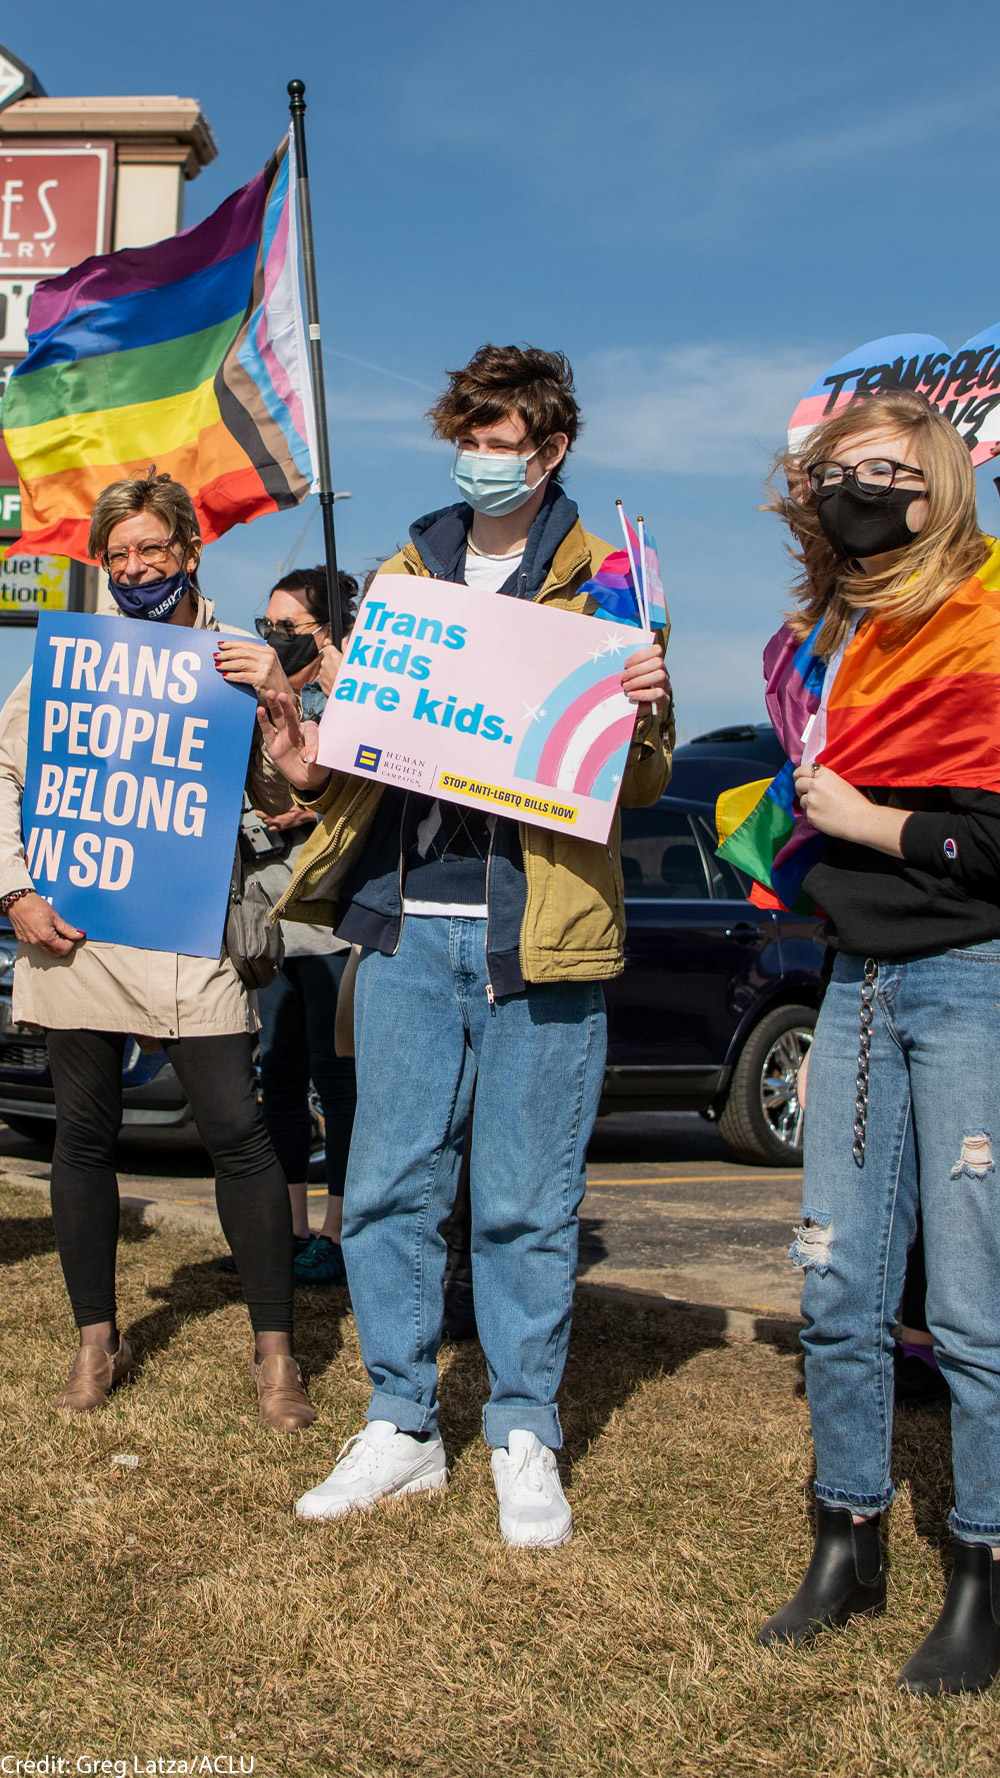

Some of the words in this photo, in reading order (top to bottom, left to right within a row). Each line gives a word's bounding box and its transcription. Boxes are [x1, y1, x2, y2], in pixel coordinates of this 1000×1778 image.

[1, 180, 58, 240] ES
[0, 494, 22, 521] F
[0, 556, 43, 577] uet
[1, 583, 47, 602] tion
[361, 601, 468, 650] Trans
[49, 636, 202, 704] TRANS
[347, 635, 432, 681] kids
[335, 677, 400, 713] are
[412, 688, 514, 745] kids.
[43, 700, 209, 772] PEOPLE
[386, 751, 426, 767] HUMAN
[383, 761, 423, 777] RIGHTS
[35, 764, 208, 838] BELONG
[443, 776, 468, 790] STOP
[468, 783, 522, 807] ANTI-LGBTQ
[524, 796, 549, 813] BILLS
[550, 802, 575, 820] NOW
[26, 827, 66, 882] IN
[69, 832, 134, 891] SD
